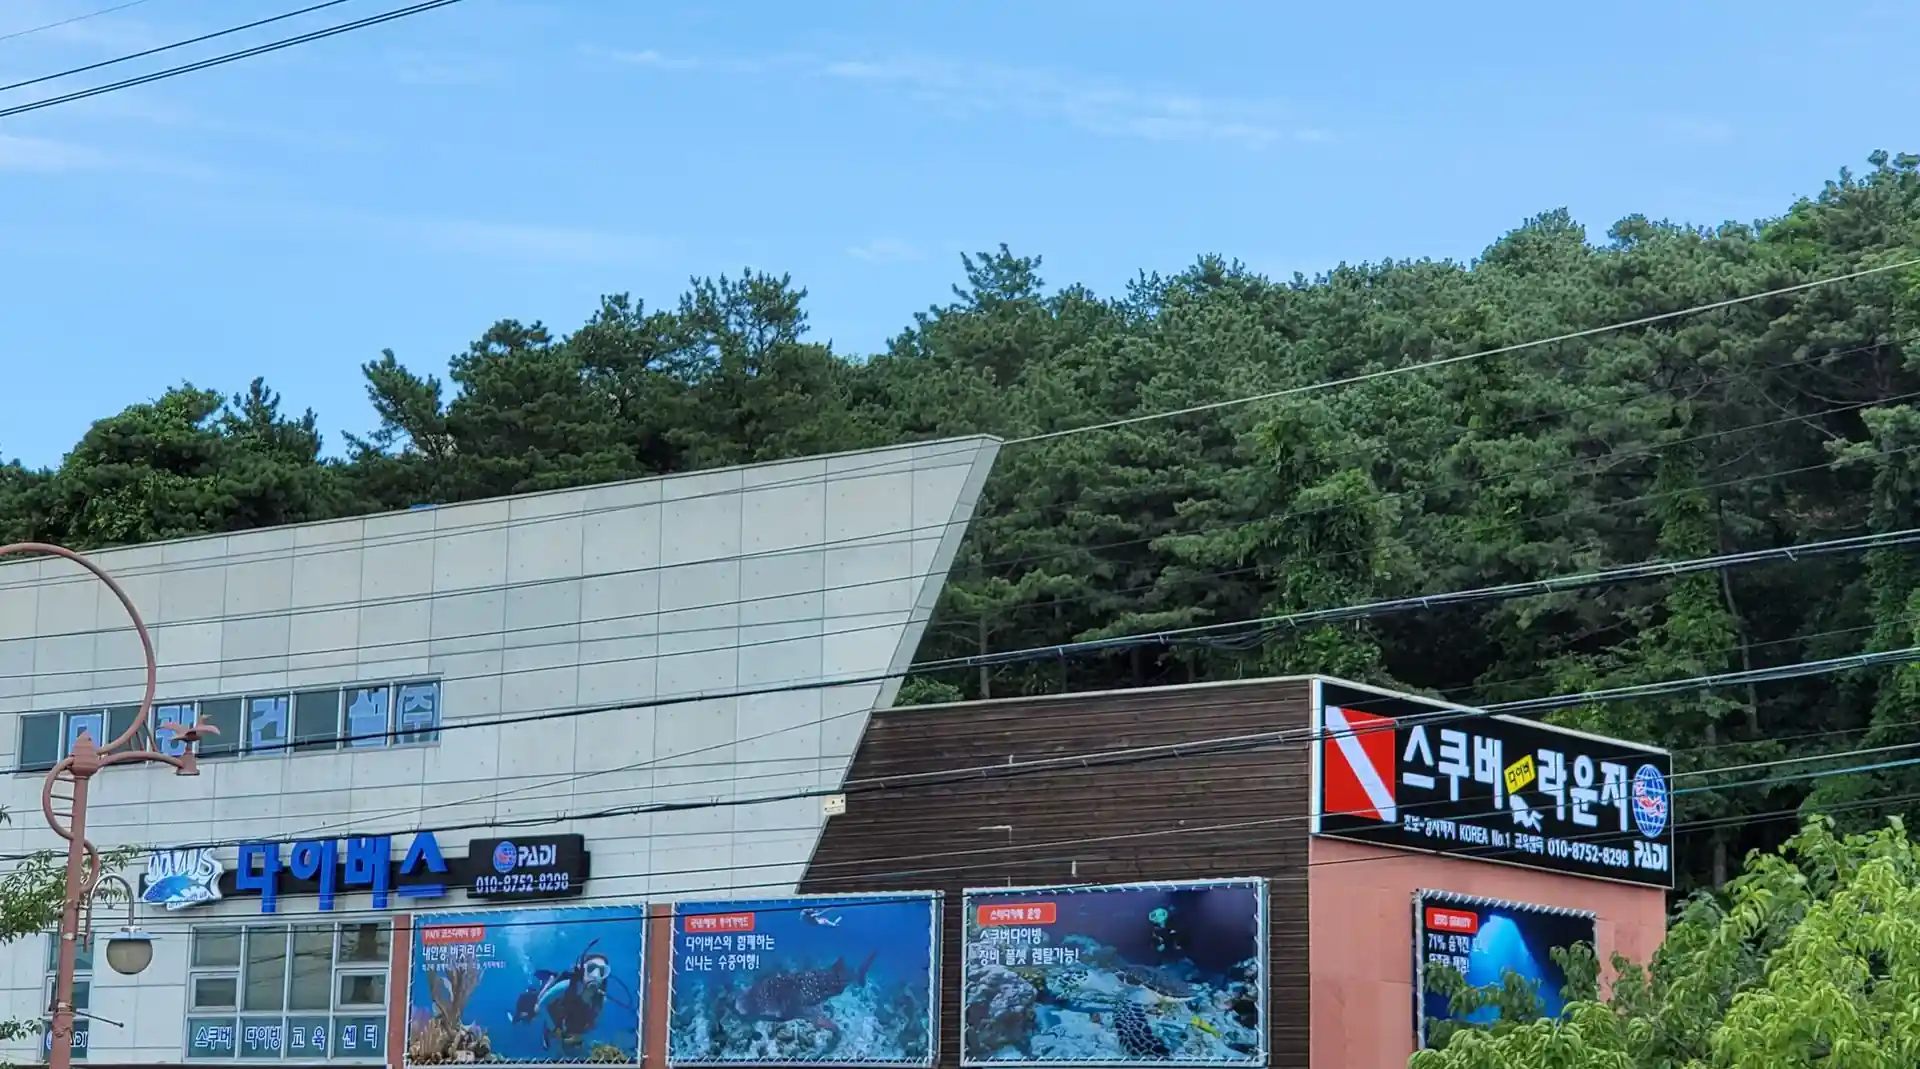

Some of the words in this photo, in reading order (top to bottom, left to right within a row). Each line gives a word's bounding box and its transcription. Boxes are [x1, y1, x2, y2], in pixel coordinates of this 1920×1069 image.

[1402, 725, 1504, 809] 스쿠버
[1537, 749, 1629, 833] 라운지
[518, 843, 557, 867] PADI
[1459, 824, 1489, 845] KOREA
[1547, 838, 1630, 868] 010-8752-8298
[1633, 840, 1669, 873] PADI
[236, 831, 448, 913] 다이버스
[475, 872, 569, 894] 010-8752-8298
[685, 935, 732, 952] 다이버스와
[737, 934, 775, 951] 함께하는
[979, 928, 1042, 945] 스쿠버다이빙
[684, 955, 713, 971] 신나는
[718, 954, 760, 971] 수중여행!
[979, 949, 999, 966] 장비
[1031, 948, 1079, 966] 렌탈가능!
[195, 1026, 233, 1050] 스쿠버
[245, 1026, 282, 1050] 다이빙
